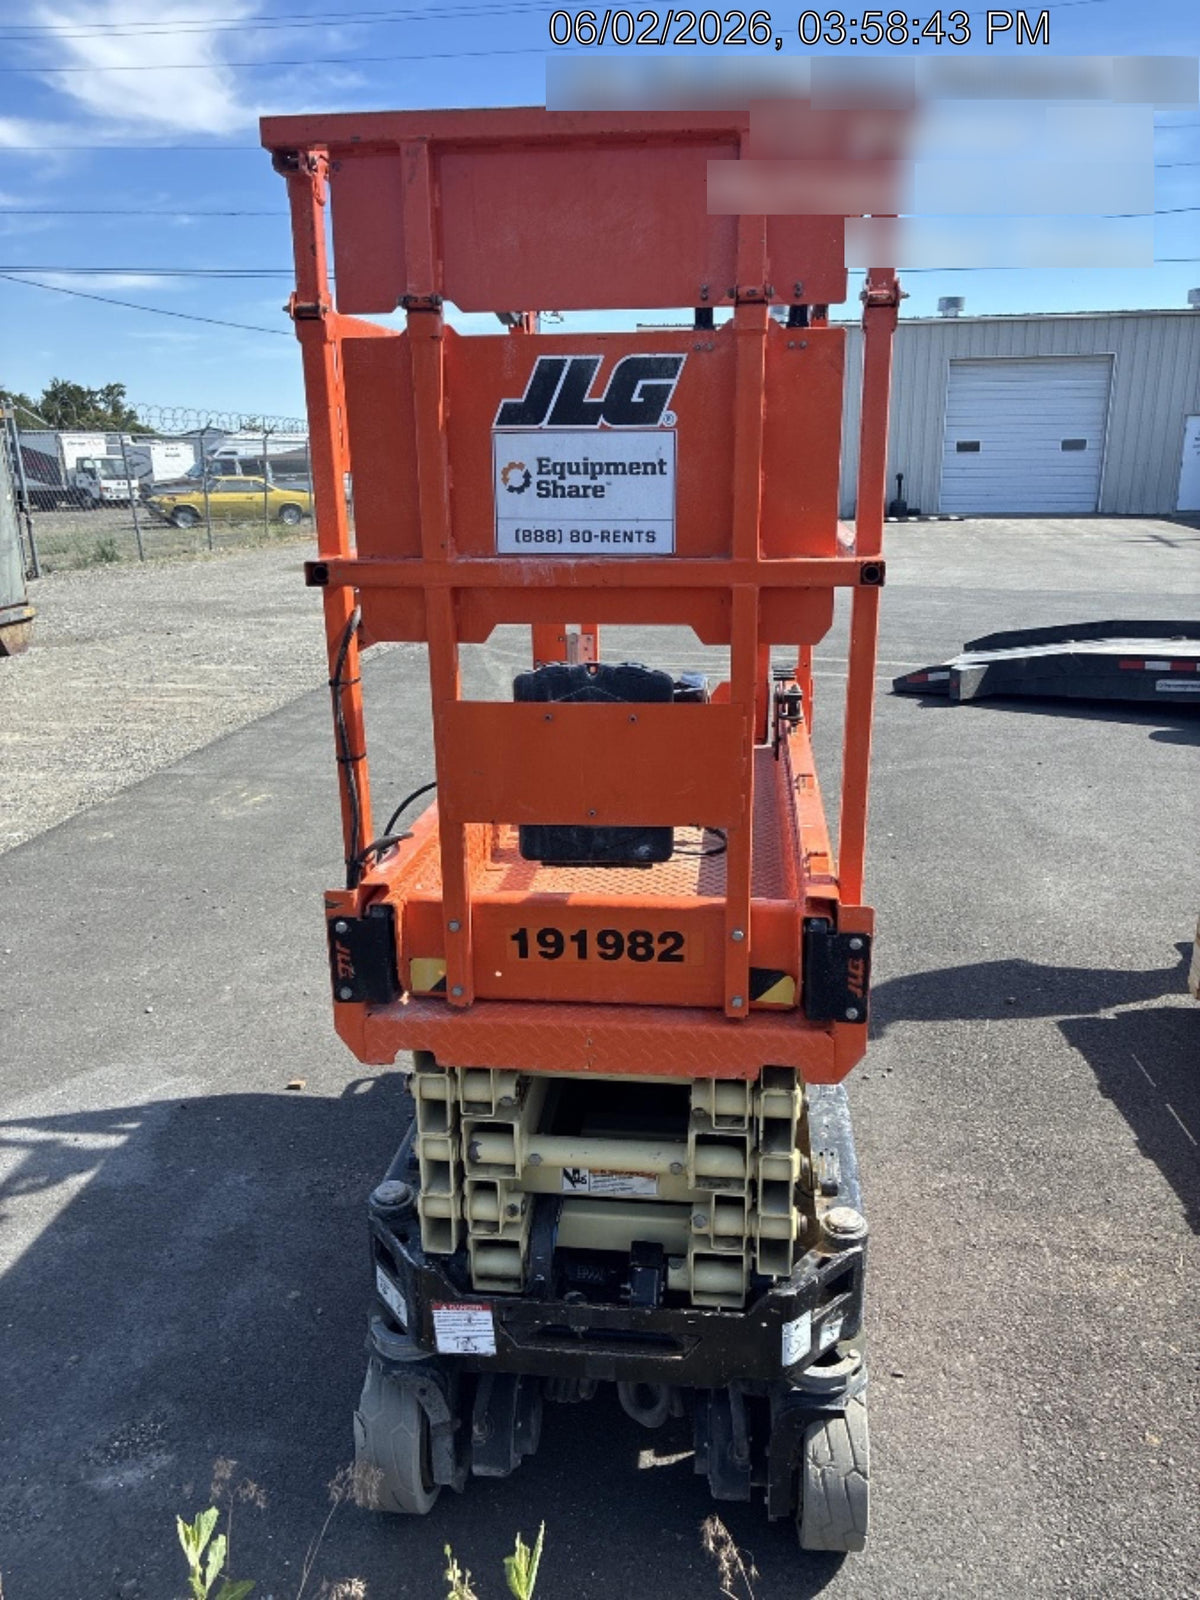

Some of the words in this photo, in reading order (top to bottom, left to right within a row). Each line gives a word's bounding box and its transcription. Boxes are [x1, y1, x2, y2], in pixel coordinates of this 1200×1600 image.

[492, 353, 688, 429] JLG
[536, 457, 667, 480] Equipment
[536, 480, 605, 499] Share
[514, 529, 563, 543] (888)
[570, 530, 656, 543] 80-RENTS
[335, 940, 354, 979] JLG
[510, 927, 685, 962] 191982
[847, 957, 864, 998] JLG
